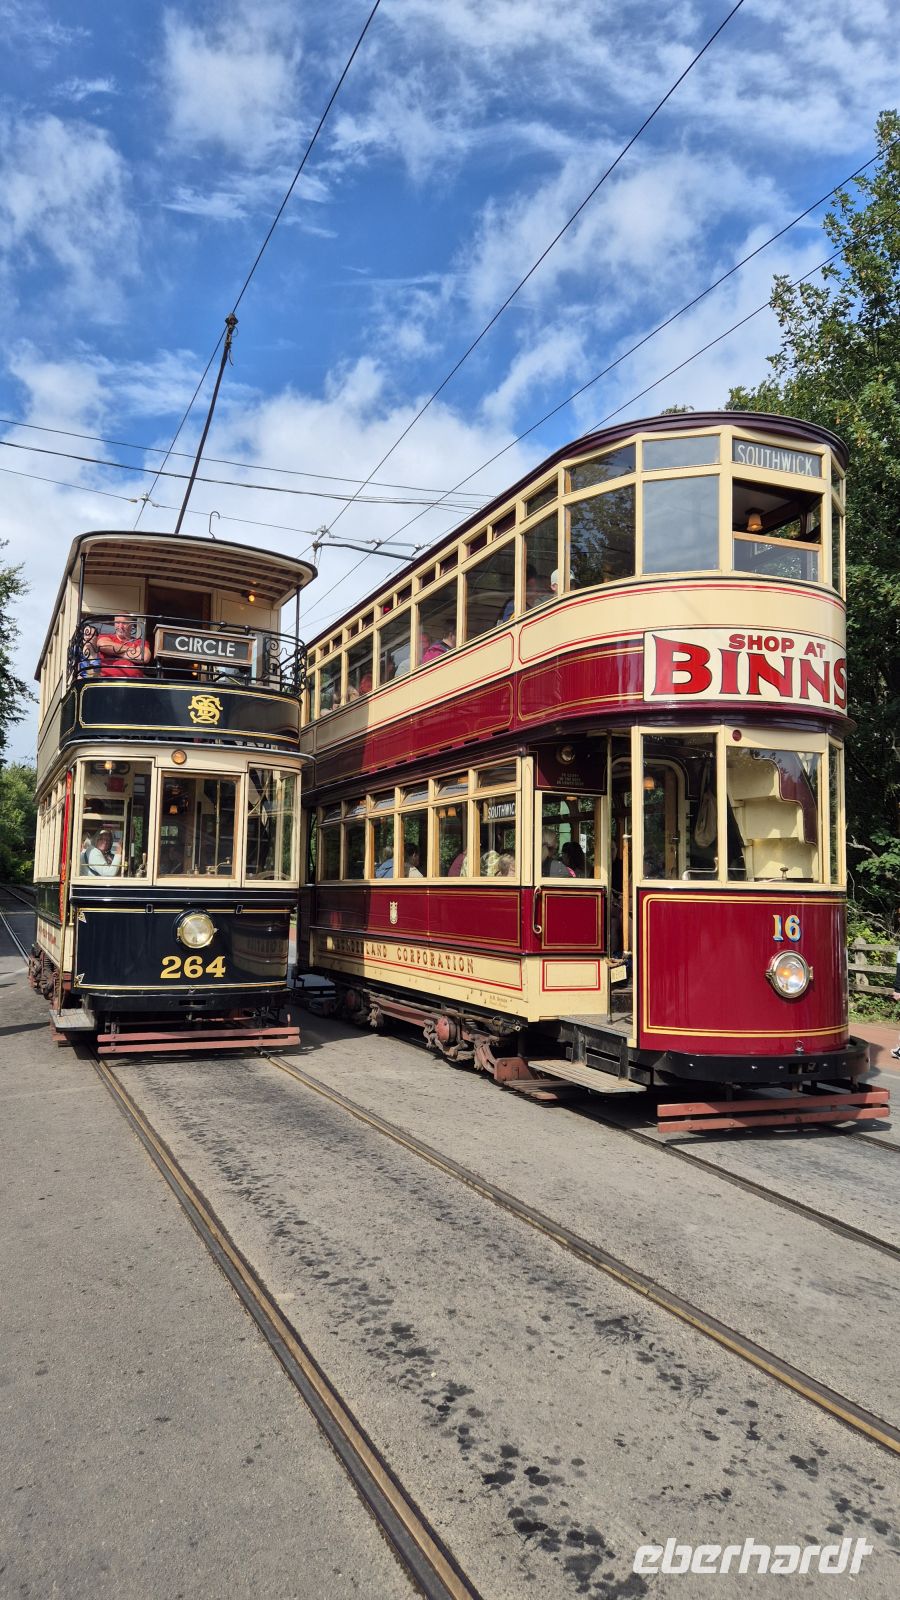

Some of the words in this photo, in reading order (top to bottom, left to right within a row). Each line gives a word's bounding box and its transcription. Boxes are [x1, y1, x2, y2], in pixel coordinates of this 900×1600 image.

[737, 444, 813, 476] SOUTHWICK
[175, 636, 236, 657] CIRCLE
[729, 633, 795, 653] SHOP
[804, 641, 826, 658] AT
[651, 634, 846, 710] BINNS
[487, 802, 515, 820] SOUTHWIC
[773, 914, 801, 942] 16
[160, 955, 226, 979] 264
[397, 946, 475, 975] CORPORATION
